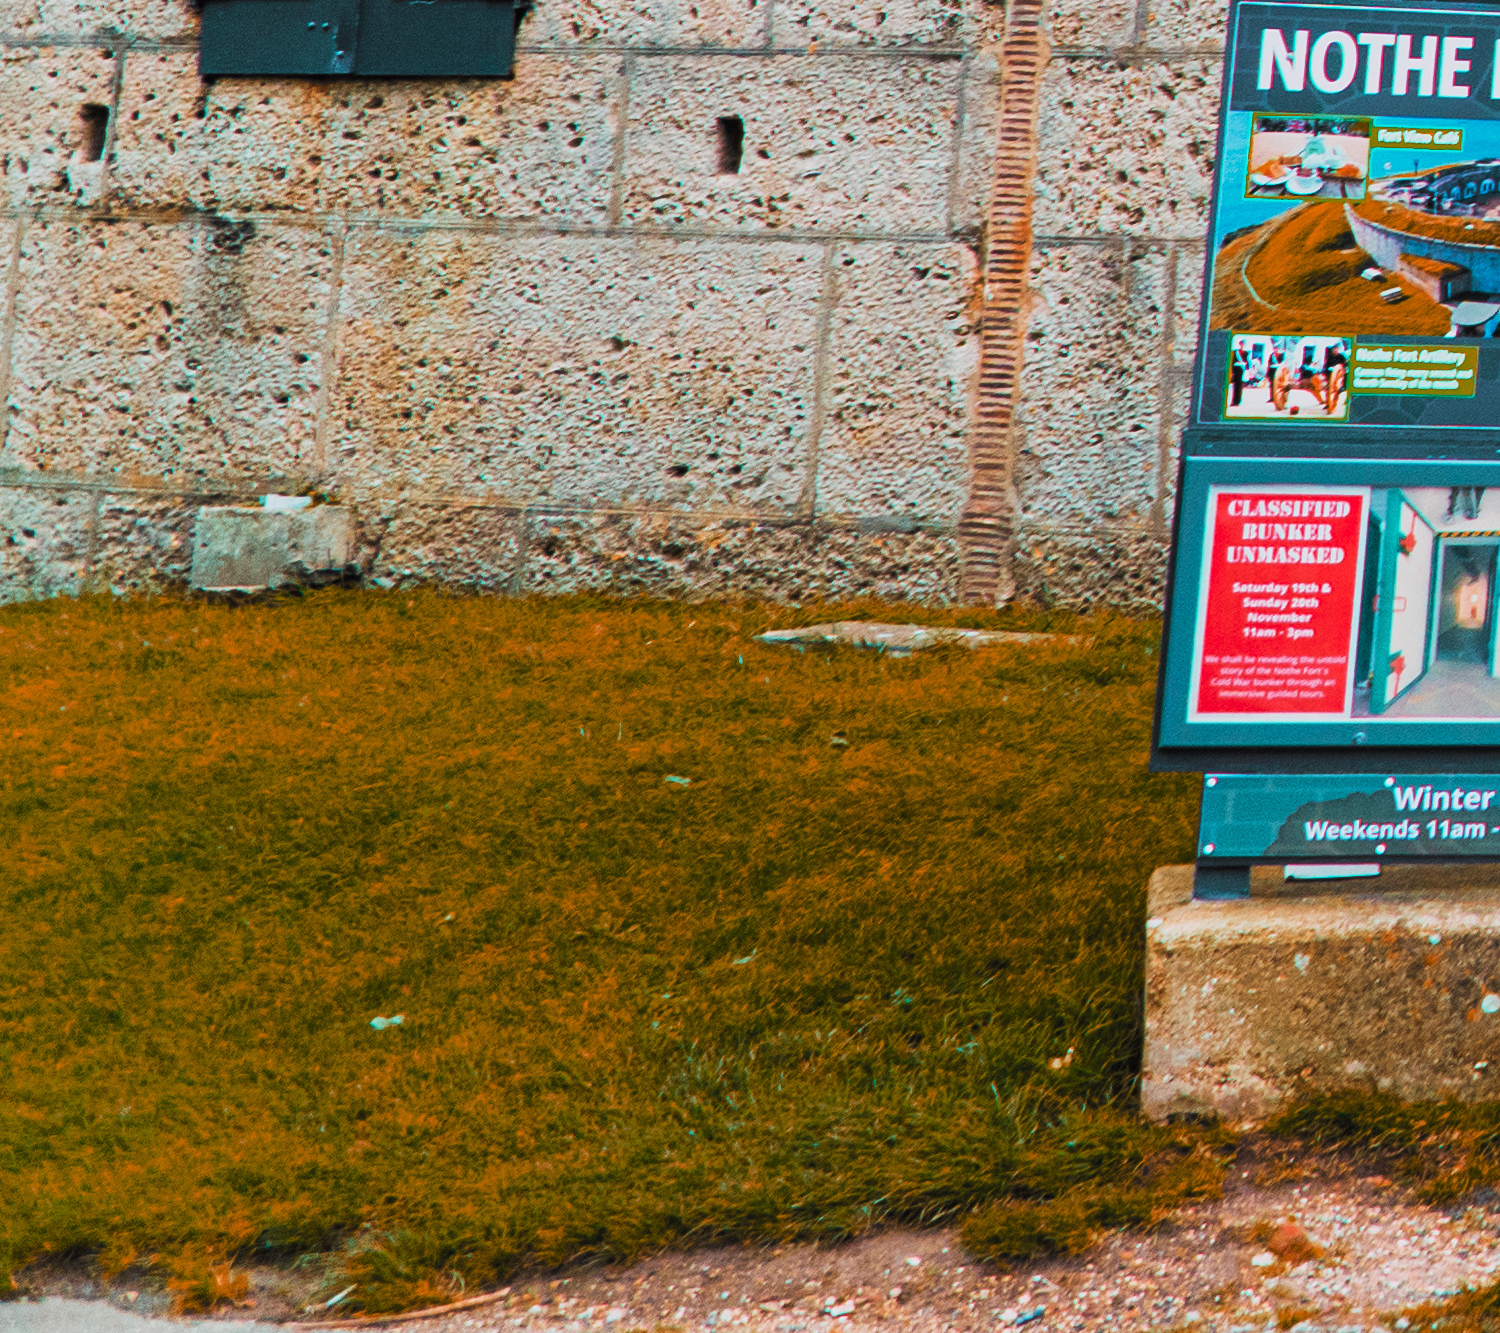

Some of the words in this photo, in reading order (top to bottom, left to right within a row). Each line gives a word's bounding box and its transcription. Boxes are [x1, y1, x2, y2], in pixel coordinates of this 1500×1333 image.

[1257, 28, 1475, 99] NOTHE
[1228, 499, 1350, 518] CLASSIFIED
[1242, 523, 1332, 541] BUNKER
[1226, 546, 1345, 564] UNMASKED
[1232, 582, 1289, 596] Saturday
[1292, 583, 1319, 594] 19th
[1321, 583, 1332, 594] &
[1242, 597, 1289, 610] Sunday
[1291, 598, 1319, 608] 20th
[1247, 612, 1313, 623] November
[1243, 627, 1276, 638] 11am
[1287, 627, 1314, 640] 3pm
[1205, 656, 1219, 664] We
[1221, 656, 1242, 664] shall
[1244, 656, 1256, 664] be
[1257, 656, 1298, 666] revealing
[1300, 656, 1315, 664] the
[1316, 656, 1346, 664] untold
[1220, 667, 1243, 676] story
[1245, 666, 1256, 675] of
[1257, 667, 1271, 675] the
[1211, 678, 1232, 687] Cold
[1233, 678, 1251, 687] War
[1253, 678, 1285, 687] bunker
[1287, 678, 1322, 688] through
[1324, 679, 1336, 687] an
[1218, 690, 1265, 698] immersive
[1267, 690, 1298, 700] guided
[1393, 785, 1496, 811] Winter
[1304, 819, 1420, 841] Weekends
[1426, 819, 1486, 839] 11am
